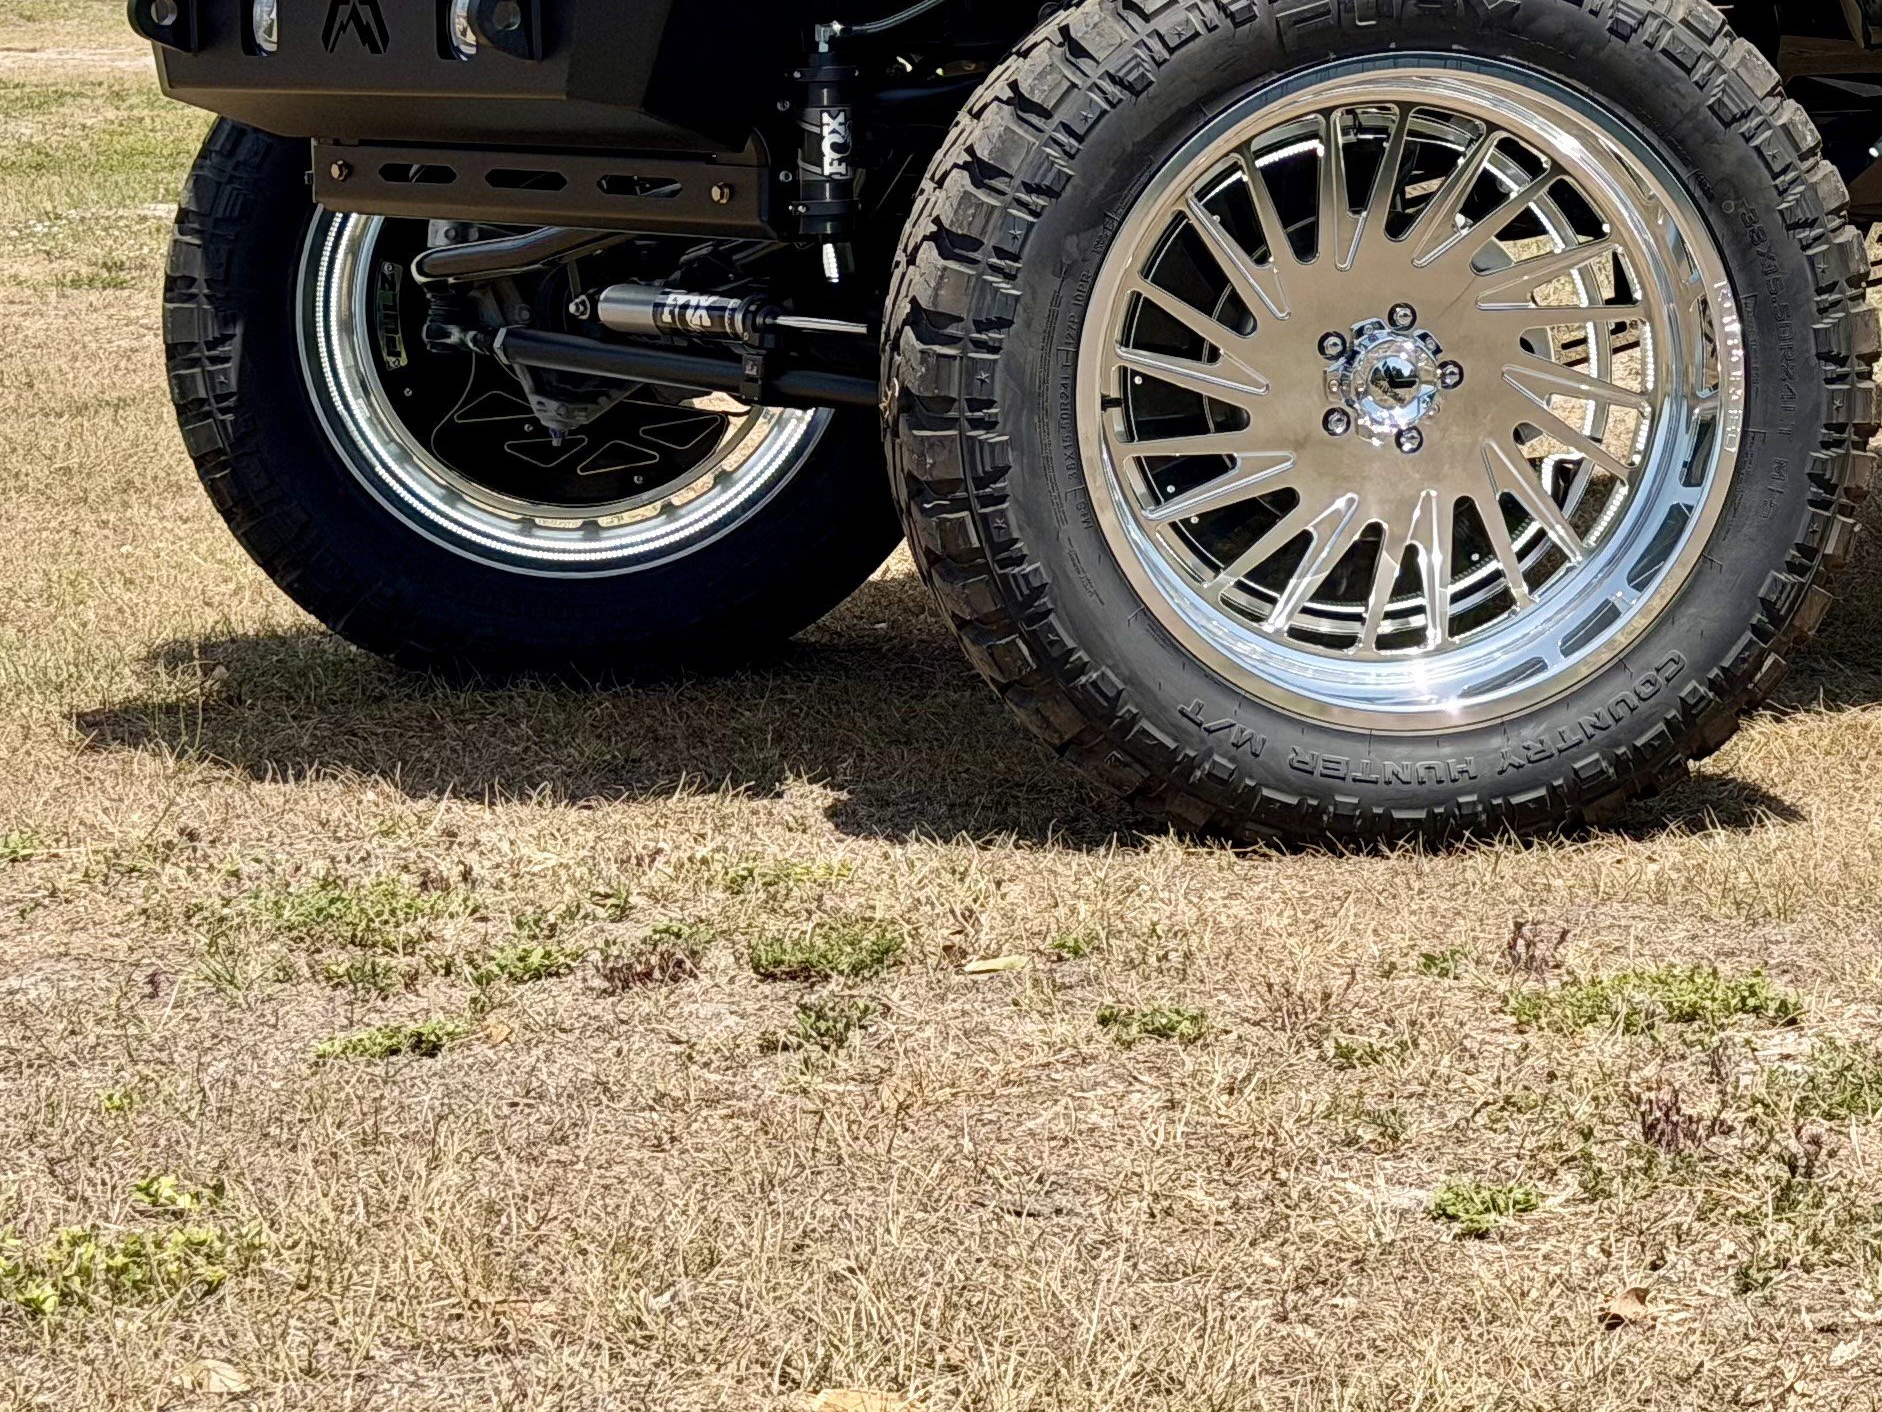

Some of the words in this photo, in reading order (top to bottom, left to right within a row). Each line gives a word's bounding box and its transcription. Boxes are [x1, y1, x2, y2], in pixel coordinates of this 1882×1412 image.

[821, 110, 850, 178] FOX
[1177, 697, 1268, 759] M/T
[1498, 649, 1688, 775] COUNTRY
[1288, 745, 1479, 786] HUNTER
